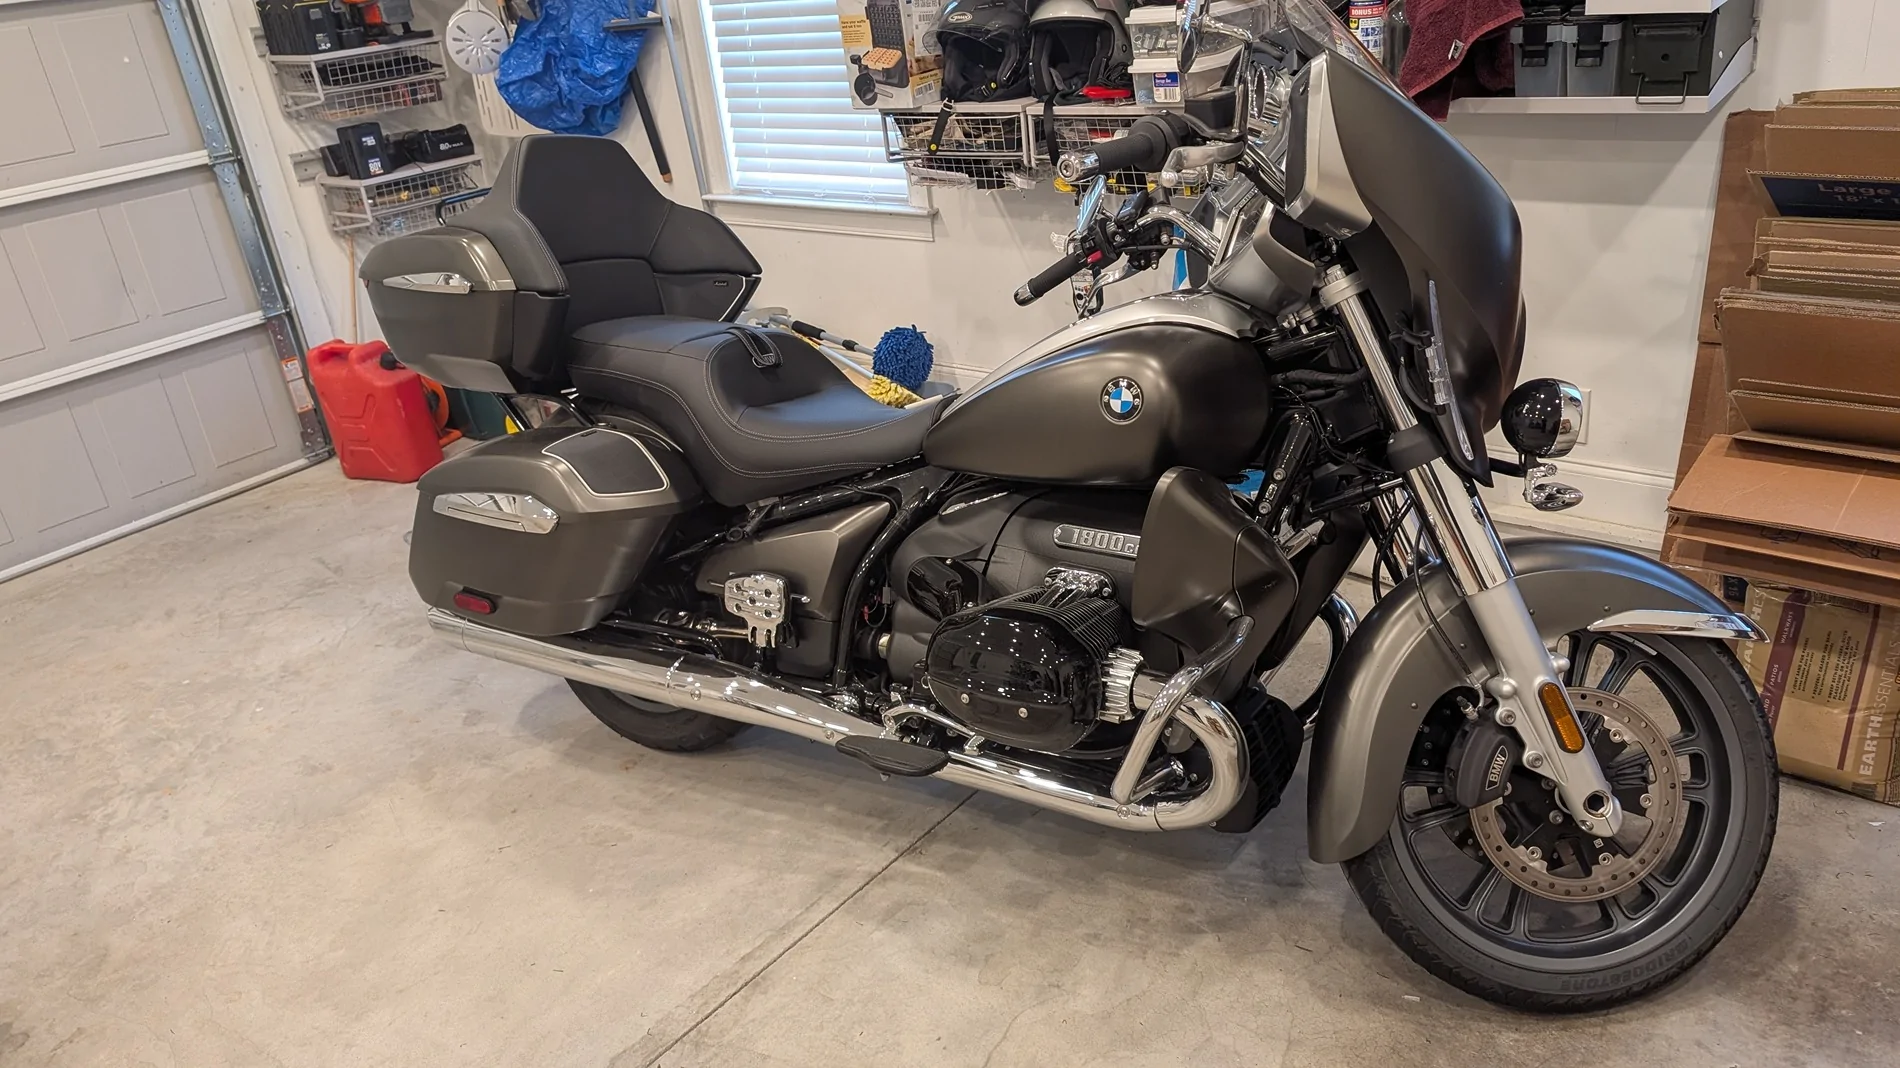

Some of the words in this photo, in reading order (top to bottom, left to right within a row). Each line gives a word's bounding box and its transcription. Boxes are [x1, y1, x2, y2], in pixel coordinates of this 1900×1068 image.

[1817, 183, 1892, 195] Large
[1768, 663, 1780, 686] PATIOS
[1780, 610, 1794, 644] WALKWAYS
[1490, 754, 1506, 782] BMW
